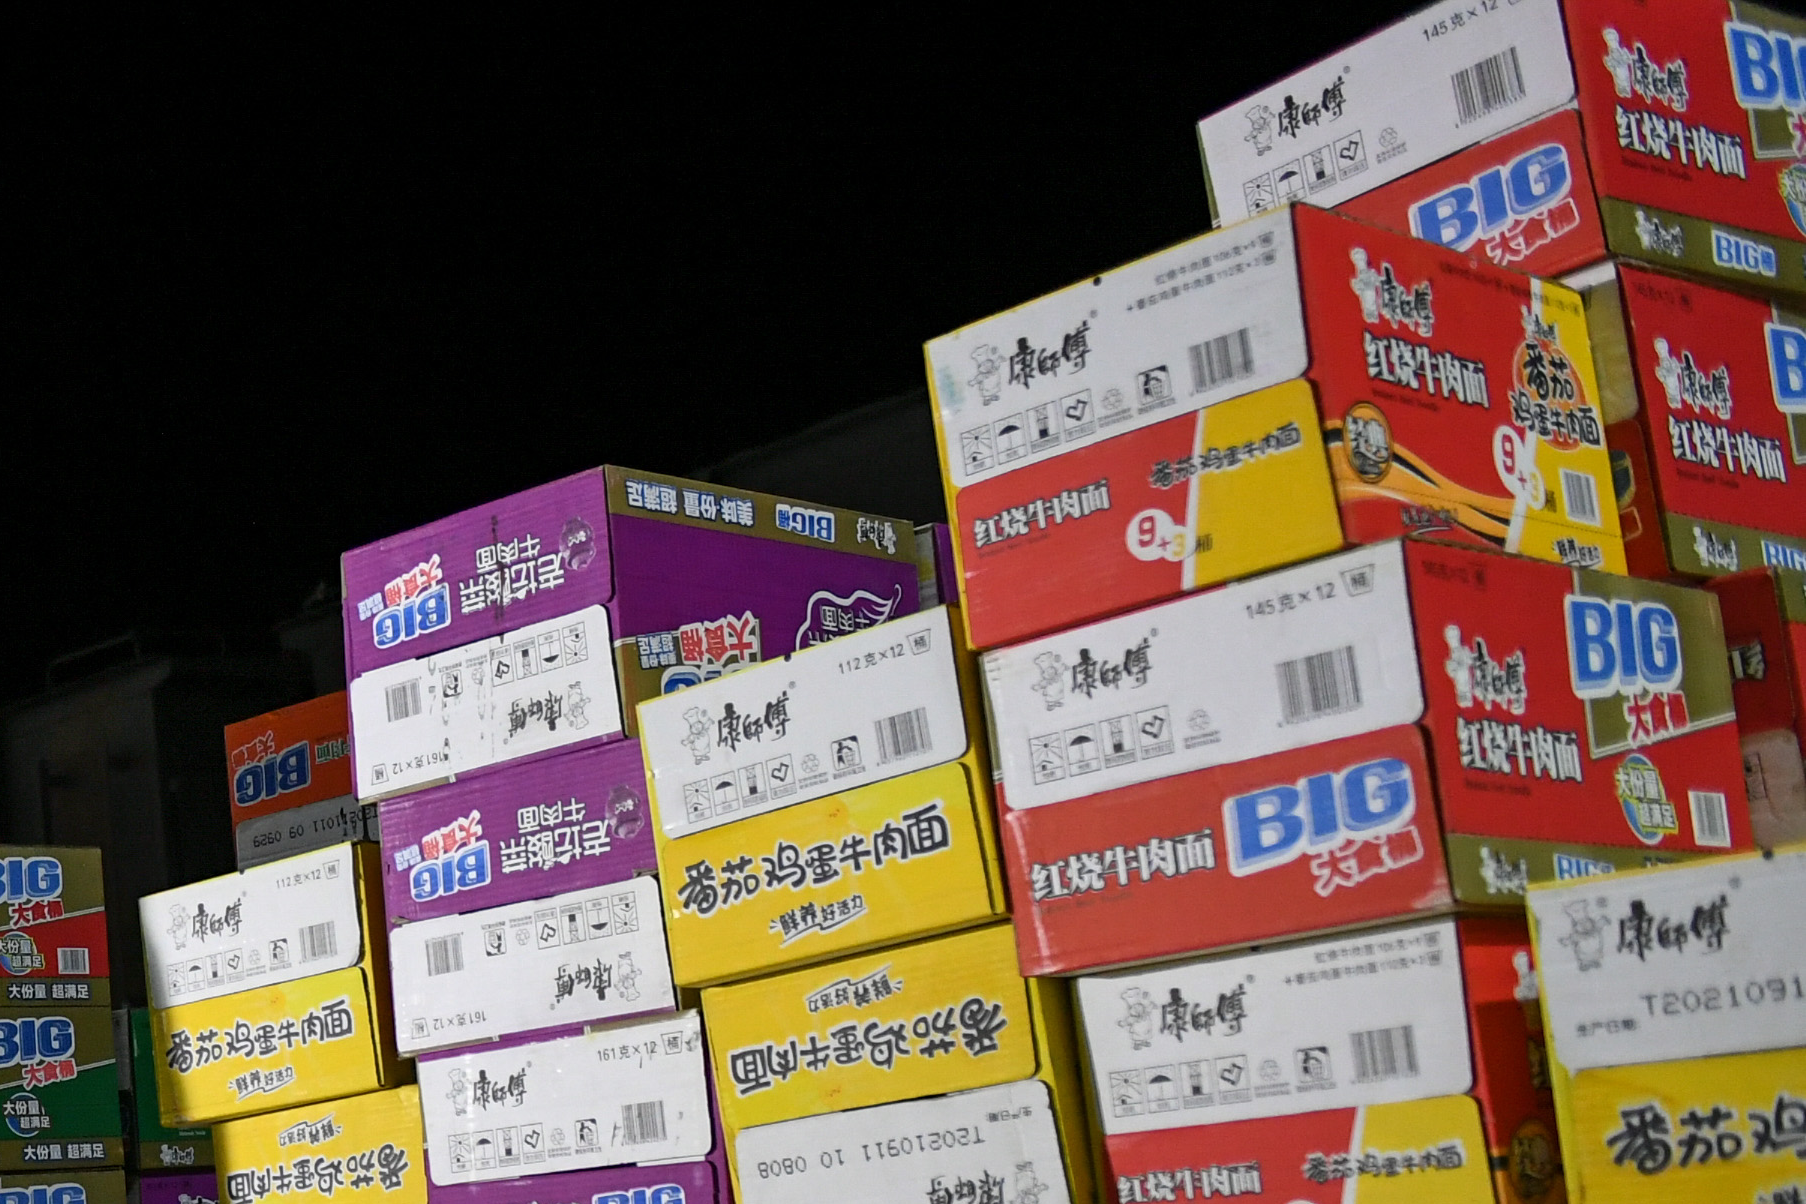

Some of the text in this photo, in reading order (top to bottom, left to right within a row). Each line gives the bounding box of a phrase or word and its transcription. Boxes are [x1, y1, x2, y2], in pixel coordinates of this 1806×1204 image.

[1615, 103, 1747, 180] 红烧牛肉面
[1409, 144, 1572, 252] BIG
[1363, 331, 1491, 409] 红烧牛肉面
[1522, 343, 1576, 402] 番茄
[1510, 390, 1604, 448] 鸡蛋牛肉面
[1149, 422, 1304, 490] 番茄鸡蛋牛肉面
[1668, 414, 1788, 484] 红烧牛肉面
[626, 482, 679, 515] 超满足
[974, 479, 1111, 550] 红烧牛肉面
[475, 533, 542, 567] 牛肉面
[384, 554, 444, 607] 大食桶
[459, 548, 566, 619] 老坛酸菜
[374, 581, 451, 650] BIG
[680, 611, 758, 667] 大食桶
[1565, 595, 1683, 698] BIG
[236, 741, 311, 806] BIG
[1457, 716, 1582, 783] 红烧牛肉面
[289, 823, 305, 840] 09
[422, 809, 484, 861] 大食桶
[516, 798, 587, 834] 牛肉面
[1222, 757, 1415, 878] BIG
[410, 840, 491, 902] BIG
[500, 819, 612, 875] 老坛酸菜
[678, 802, 950, 916] 番茄鸡蛋牛肉面
[1031, 829, 1215, 902] 红烧牛肉面
[9, 898, 65, 929] 大食桶
[779, 893, 866, 938] 鲜养好活力
[11, 954, 44, 970] 超满足
[7, 983, 91, 1000] 大份量 超满足
[165, 1000, 354, 1075] 番茄鸡蛋牛肉面
[729, 998, 1009, 1096] 番茄鸡蛋牛肉面
[23, 1058, 78, 1089] 大食桶
[3, 1099, 41, 1117] 大份量
[20, 1113, 51, 1131] 超满足
[23, 1142, 106, 1161] 大份量 超满足
[757, 1125, 986, 1181] T20210911 10 0808
[1302, 1142, 1465, 1184] 番茄鸡蛋牛肉面
